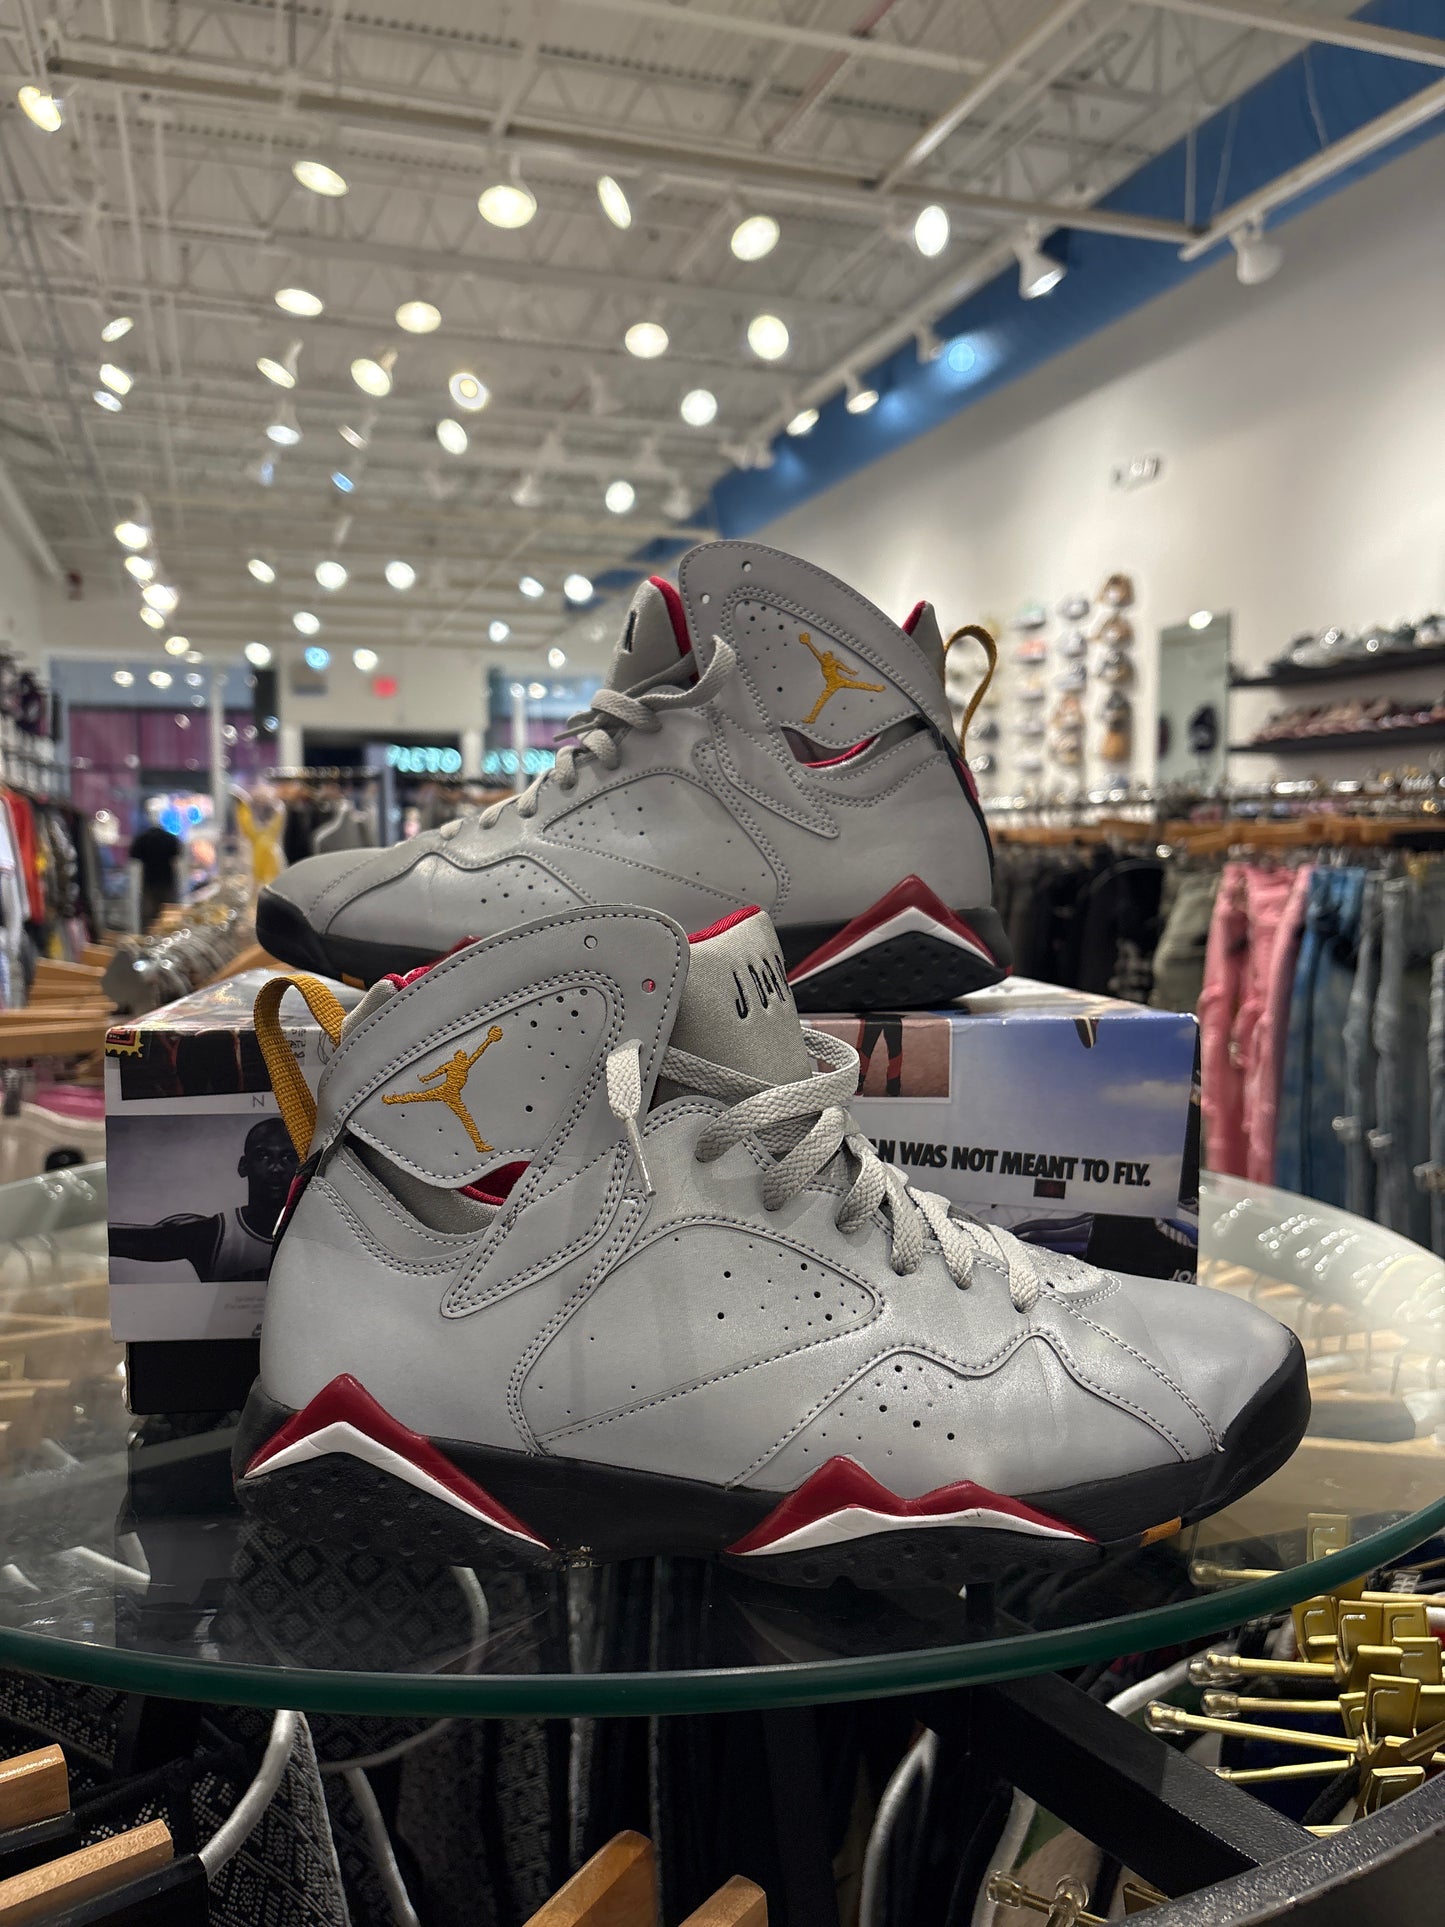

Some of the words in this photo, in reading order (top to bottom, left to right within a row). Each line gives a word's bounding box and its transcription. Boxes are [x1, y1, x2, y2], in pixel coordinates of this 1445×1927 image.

[899, 1141, 948, 1169] WAS
[951, 1146, 999, 1173] NOT
[999, 1151, 1079, 1181] MEANT
[1081, 1158, 1110, 1184] TO
[1113, 1162, 1151, 1187] FLY.
